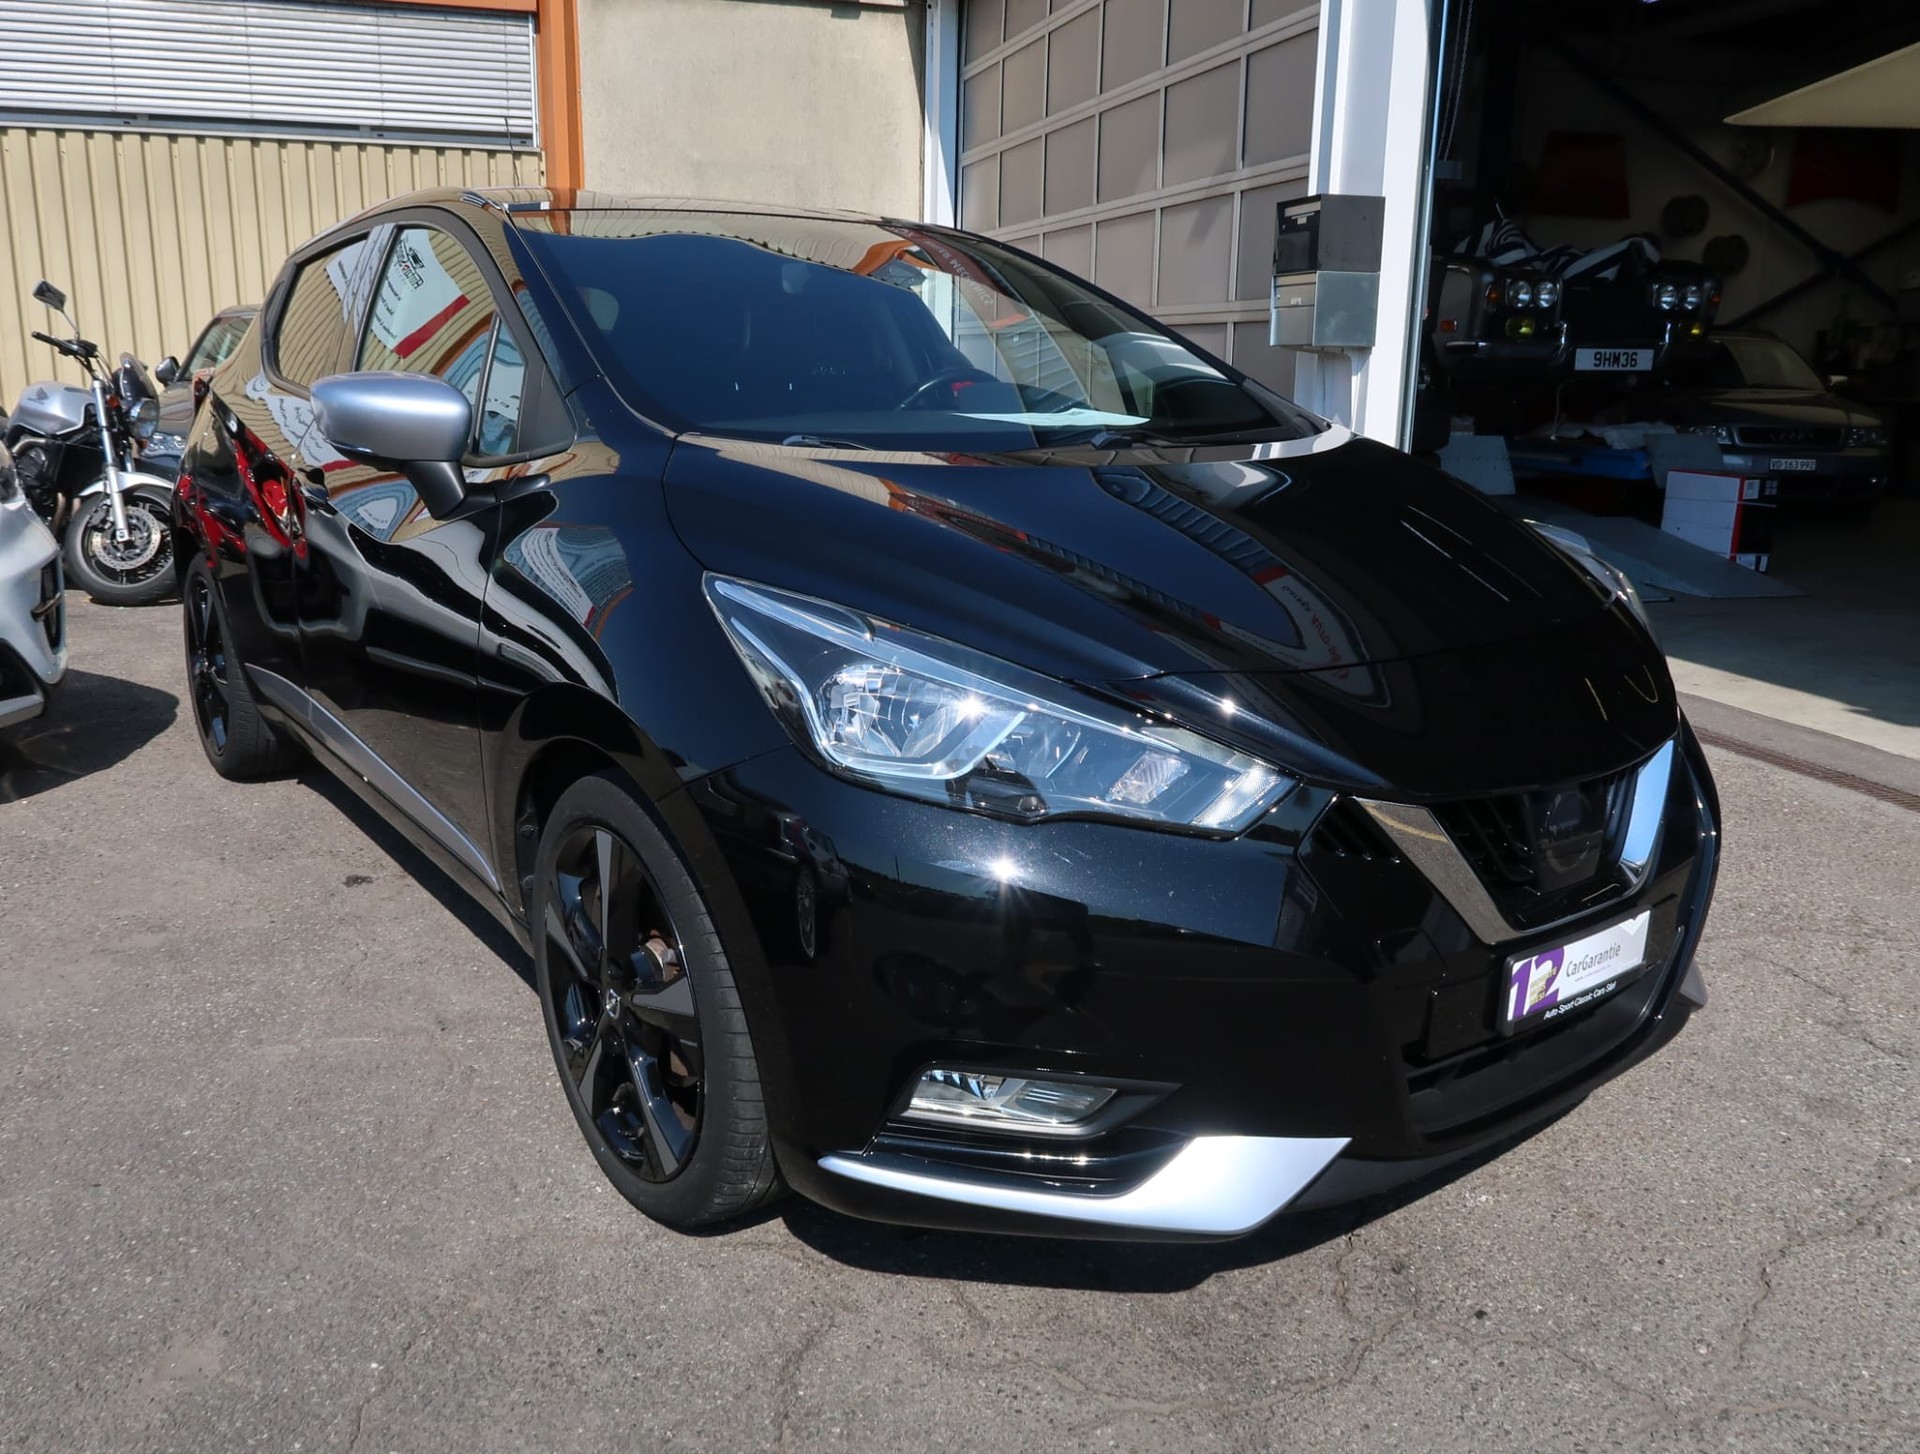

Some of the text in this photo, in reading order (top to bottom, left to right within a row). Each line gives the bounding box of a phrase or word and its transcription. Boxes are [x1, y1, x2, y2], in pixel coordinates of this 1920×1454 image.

[1593, 351, 1638, 368] 9HM36
[1566, 942, 1621, 977] CarGarantie
[1543, 1009, 1558, 1020] Auto
